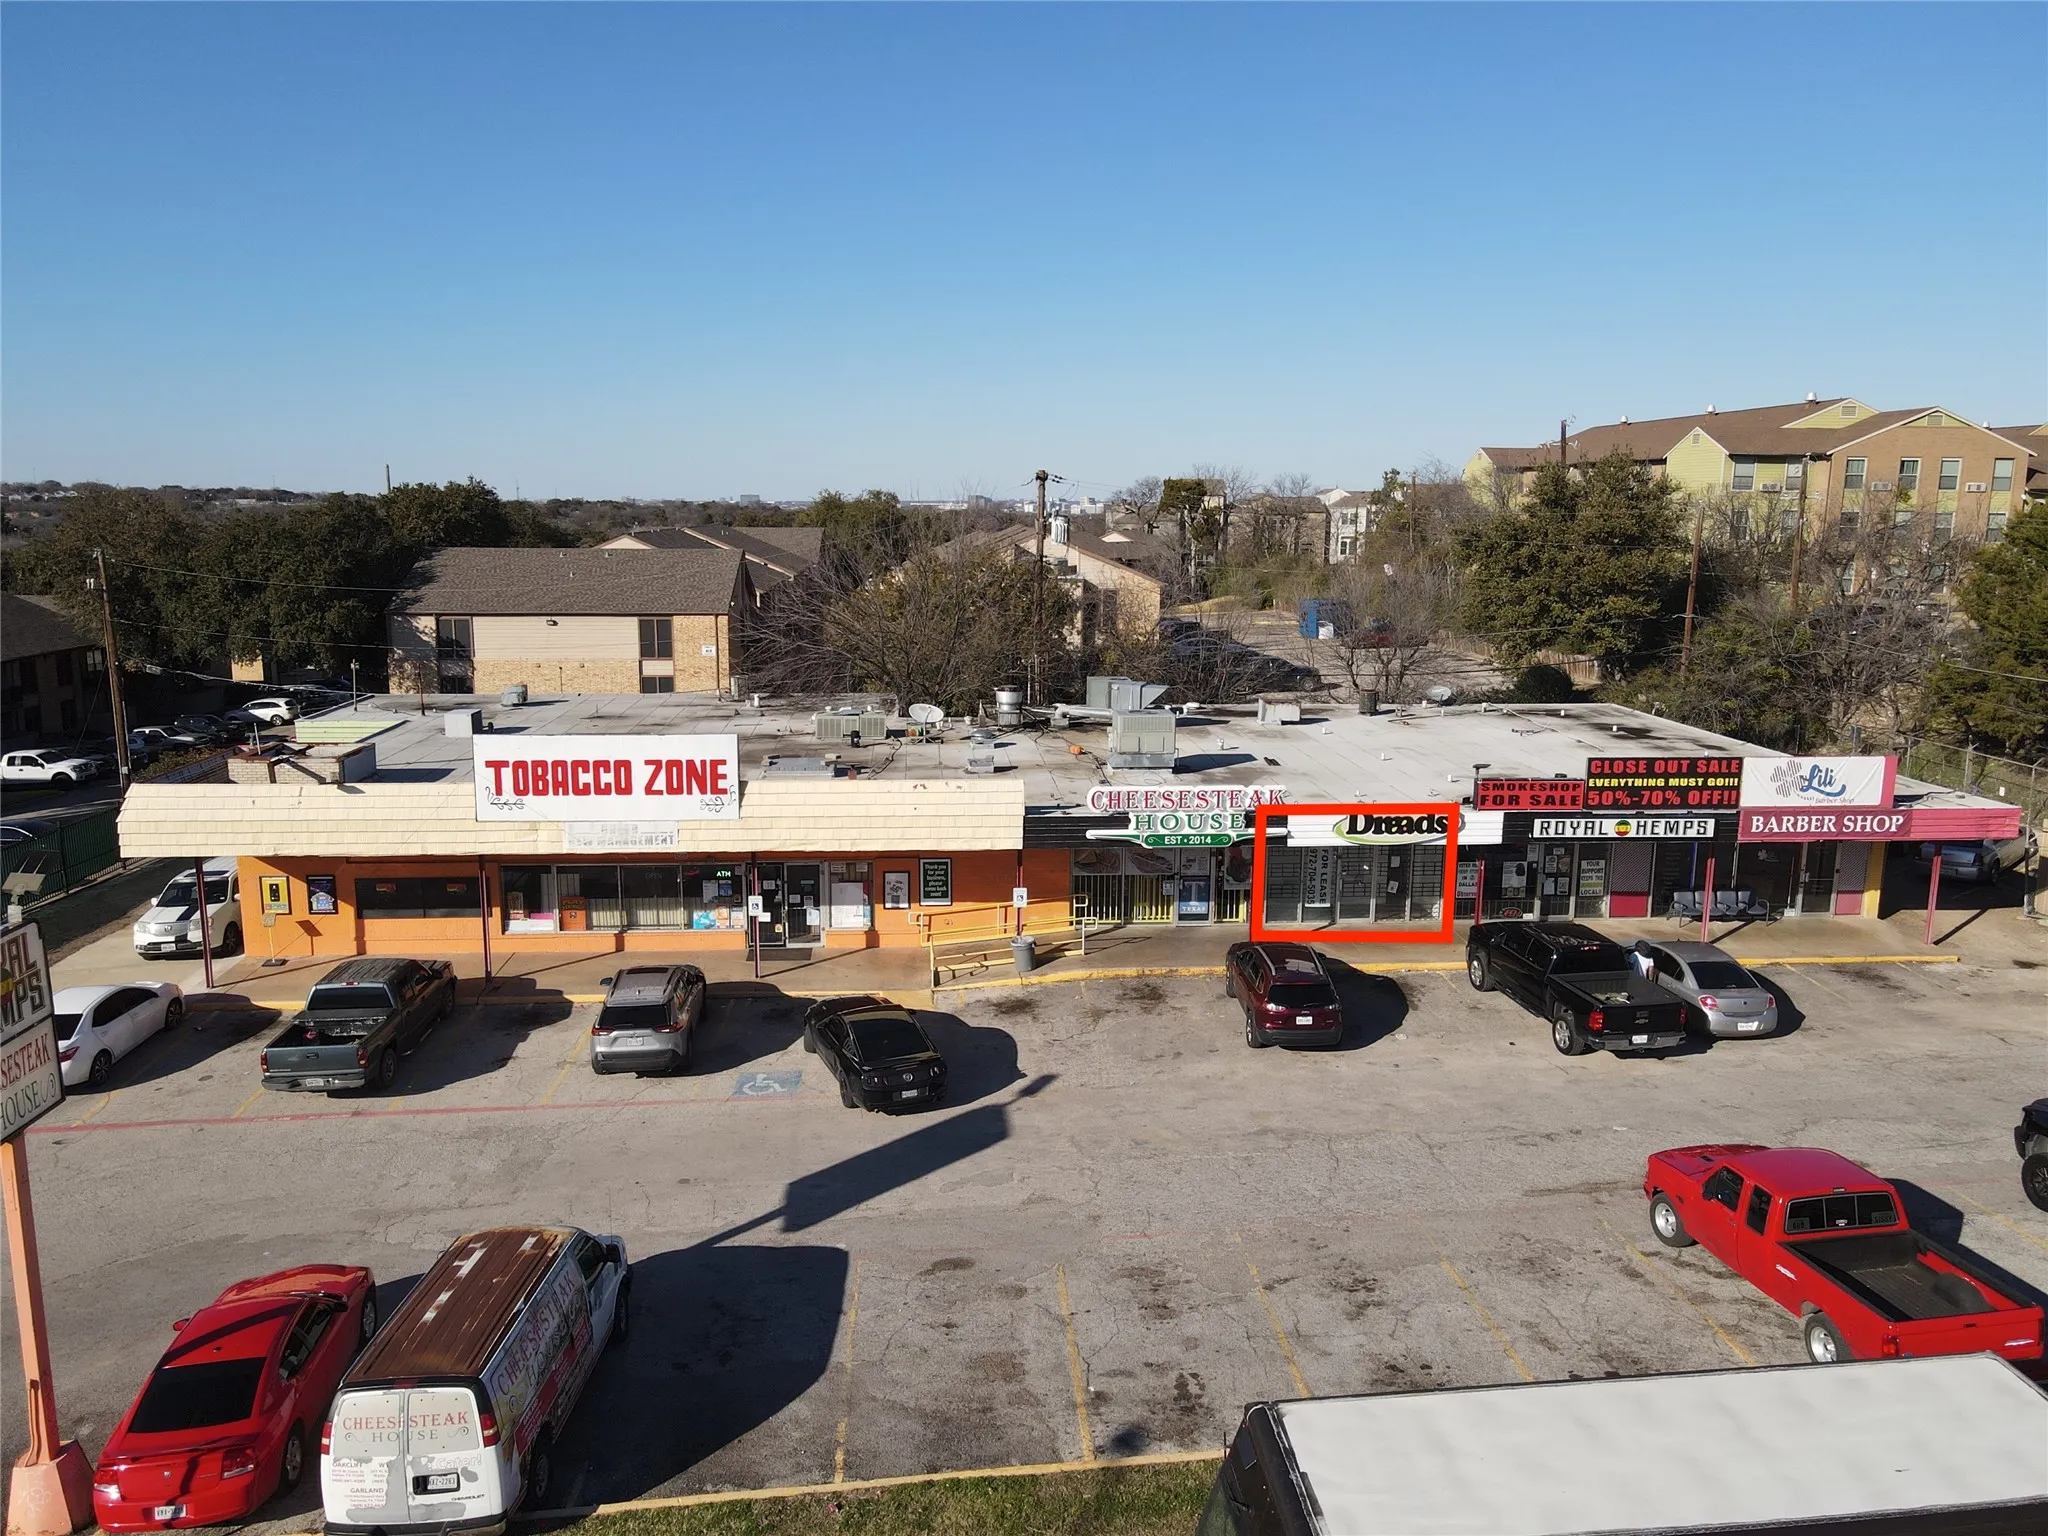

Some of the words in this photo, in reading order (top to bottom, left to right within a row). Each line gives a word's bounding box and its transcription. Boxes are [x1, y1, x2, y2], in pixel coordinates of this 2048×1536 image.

[1590, 760, 1647, 774] CLOSE
[1654, 760, 1690, 773] OUT
[1697, 759, 1740, 773] SALE
[485, 760, 632, 796] TOBACCO
[644, 759, 728, 796] ZONE
[1589, 778, 1666, 787] EVERYTHING
[1668, 777, 1705, 786] MUST
[1707, 777, 1739, 786] GO!!!
[1800, 764, 1847, 797] Lili
[1481, 782, 1582, 792] SMOKESHOP
[1091, 789, 1286, 810] CHEESESTEAK
[1480, 795, 1526, 806] FOR
[1530, 794, 1581, 806] SALE
[1588, 790, 1681, 806] 50%-70%
[1688, 790, 1737, 805] OFF!!
[1133, 813, 1246, 832] HOUSE
[1346, 814, 1449, 835] Dreads
[1539, 820, 1609, 836] ROYAL
[1636, 820, 1708, 836] HEMPS
[1751, 815, 1838, 833] BARBER
[1843, 815, 1904, 832] SHOP
[1165, 836, 1183, 845] EST
[1189, 836, 1212, 845] 2014
[1321, 848, 1329, 869] FOR
[716, 870, 731, 878] ATM
[1319, 873, 1328, 904] LEASE
